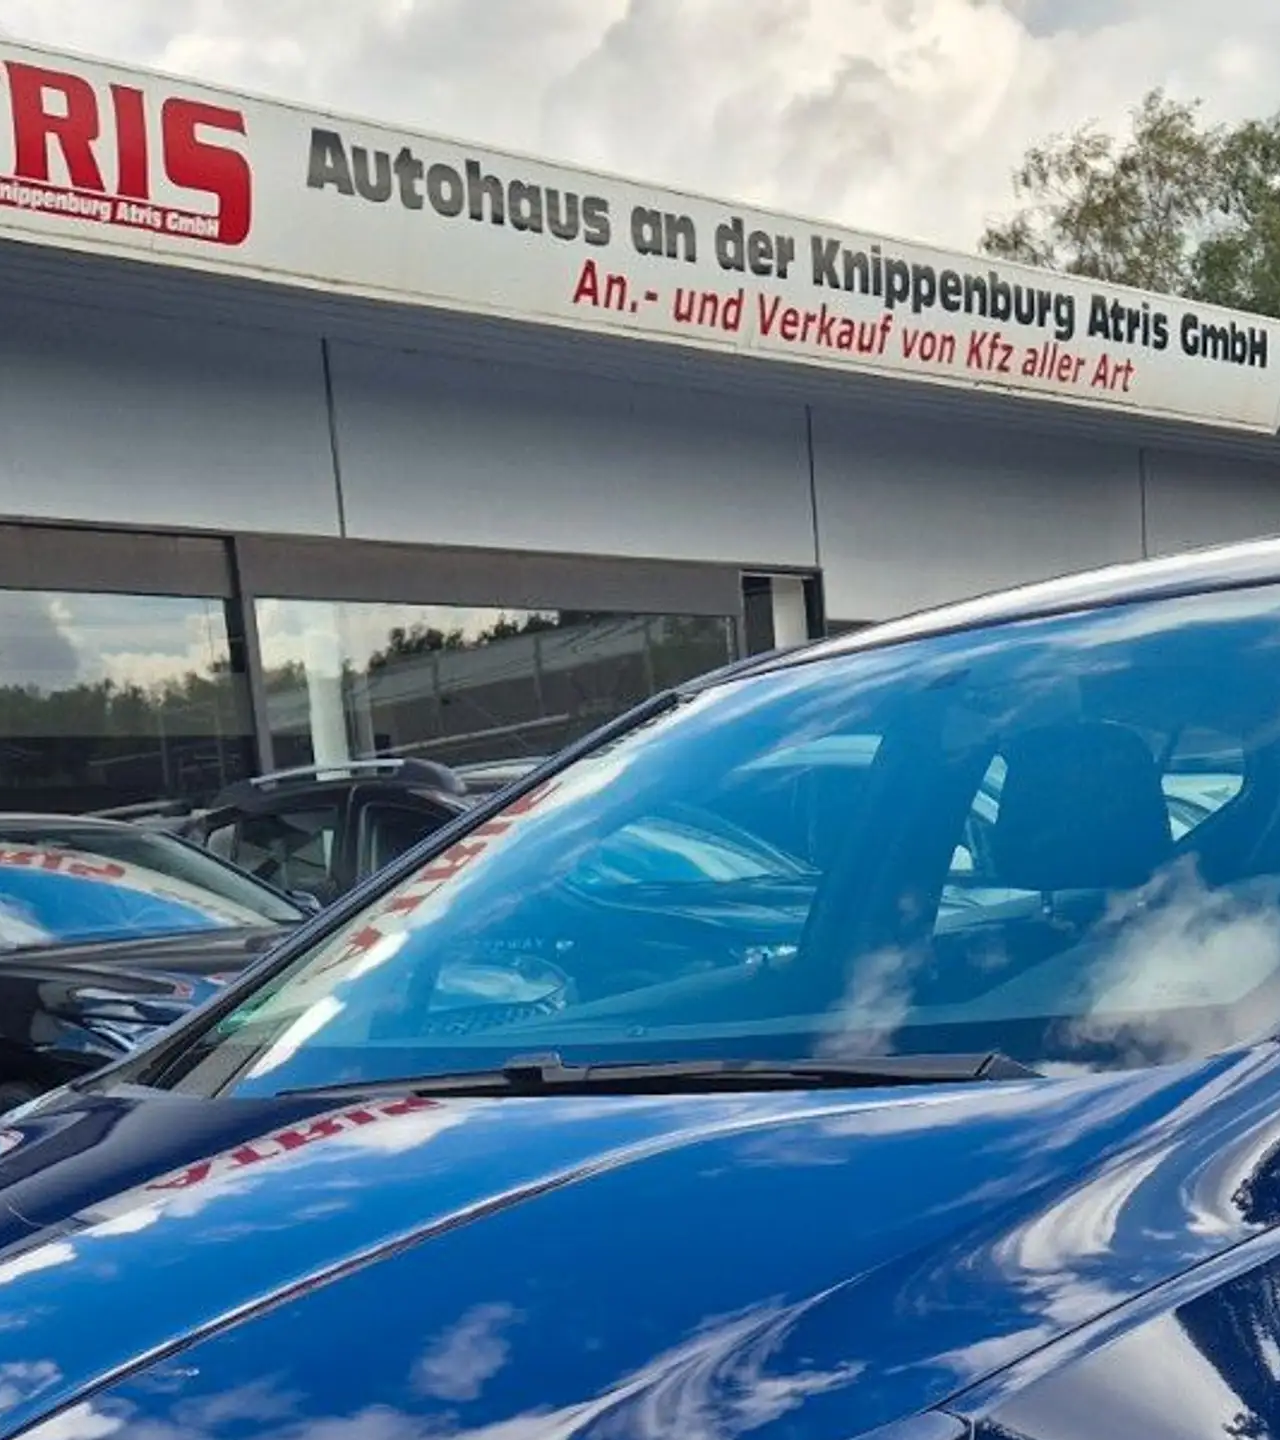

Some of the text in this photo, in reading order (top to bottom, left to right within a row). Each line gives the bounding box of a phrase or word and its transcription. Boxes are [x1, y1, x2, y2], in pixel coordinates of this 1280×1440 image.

[115, 201, 162, 230] Atris
[165, 212, 220, 239] GmbH
[305, 127, 1268, 369] Autohaus an der Knippenburg Atris GmbH
[572, 258, 1134, 394] An.- und Verkauf von Kfz aller Art
